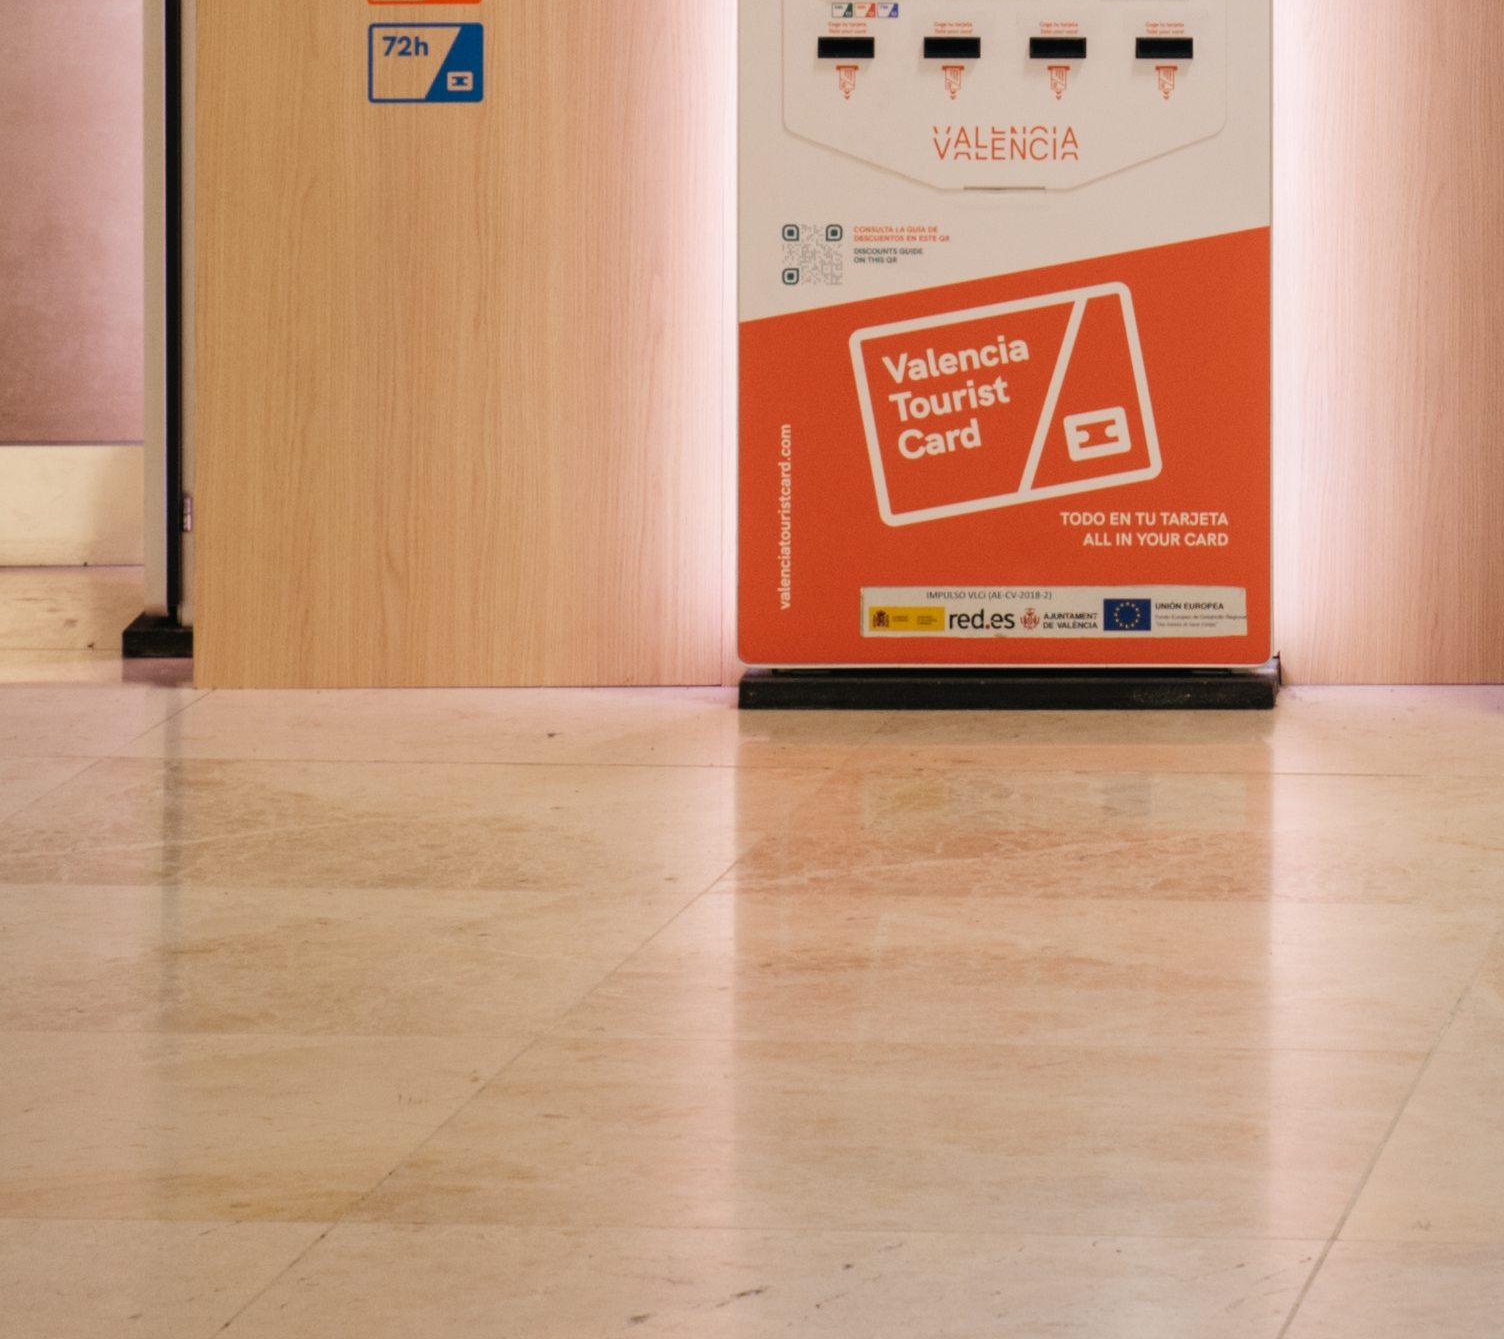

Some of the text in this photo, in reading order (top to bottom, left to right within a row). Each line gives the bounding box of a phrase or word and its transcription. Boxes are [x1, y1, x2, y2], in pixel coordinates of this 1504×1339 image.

[382, 36, 429, 56] 72h
[882, 335, 1029, 384] Valencia
[889, 376, 1011, 422] Tourist
[898, 419, 982, 460] Card
[777, 424, 792, 610] valenciatouristcard.com
[1060, 511, 1228, 526] TODO EN TU TARJETA
[1083, 532, 1229, 546] ALL IN YOUR CARD
[927, 591, 965, 599] IMPULSO
[988, 591, 1052, 600] (AE-CV-2018-2)
[1155, 602, 1182, 610] UNIÓN
[948, 607, 1016, 630] red.es
[1057, 621, 1098, 629] VALÈNCIA
